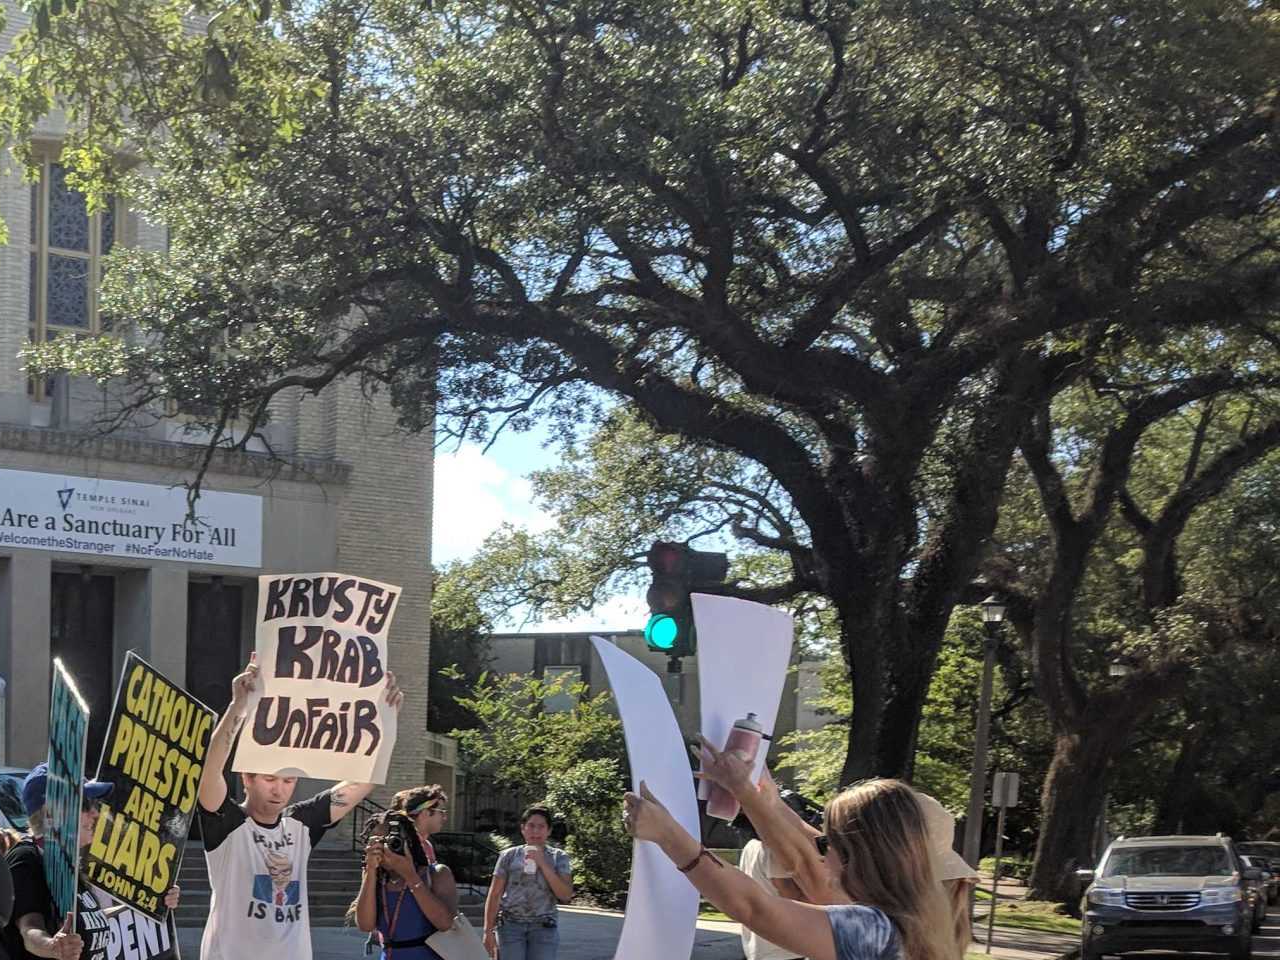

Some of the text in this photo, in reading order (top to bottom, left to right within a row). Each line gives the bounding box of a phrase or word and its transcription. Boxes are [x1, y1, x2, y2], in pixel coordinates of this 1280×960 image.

[77, 492, 150, 507] TEMPLE SINAI
[0, 507, 39, 528] Are
[44, 515, 56, 531] a
[63, 513, 166, 545] Sanctuary
[171, 523, 205, 544] For
[209, 527, 237, 547] All
[125, 543, 215, 561] #NoFearNoHate
[274, 625, 384, 688] KRAB
[126, 664, 212, 760] CATHOLIC
[109, 714, 202, 814] PRIESTS
[124, 786, 164, 832] ARE
[89, 802, 176, 894] LIARS
[88, 861, 97, 879] 1
[96, 867, 136, 900] JOHN
[136, 889, 158, 913] 2:4
[248, 901, 267, 919] IS
